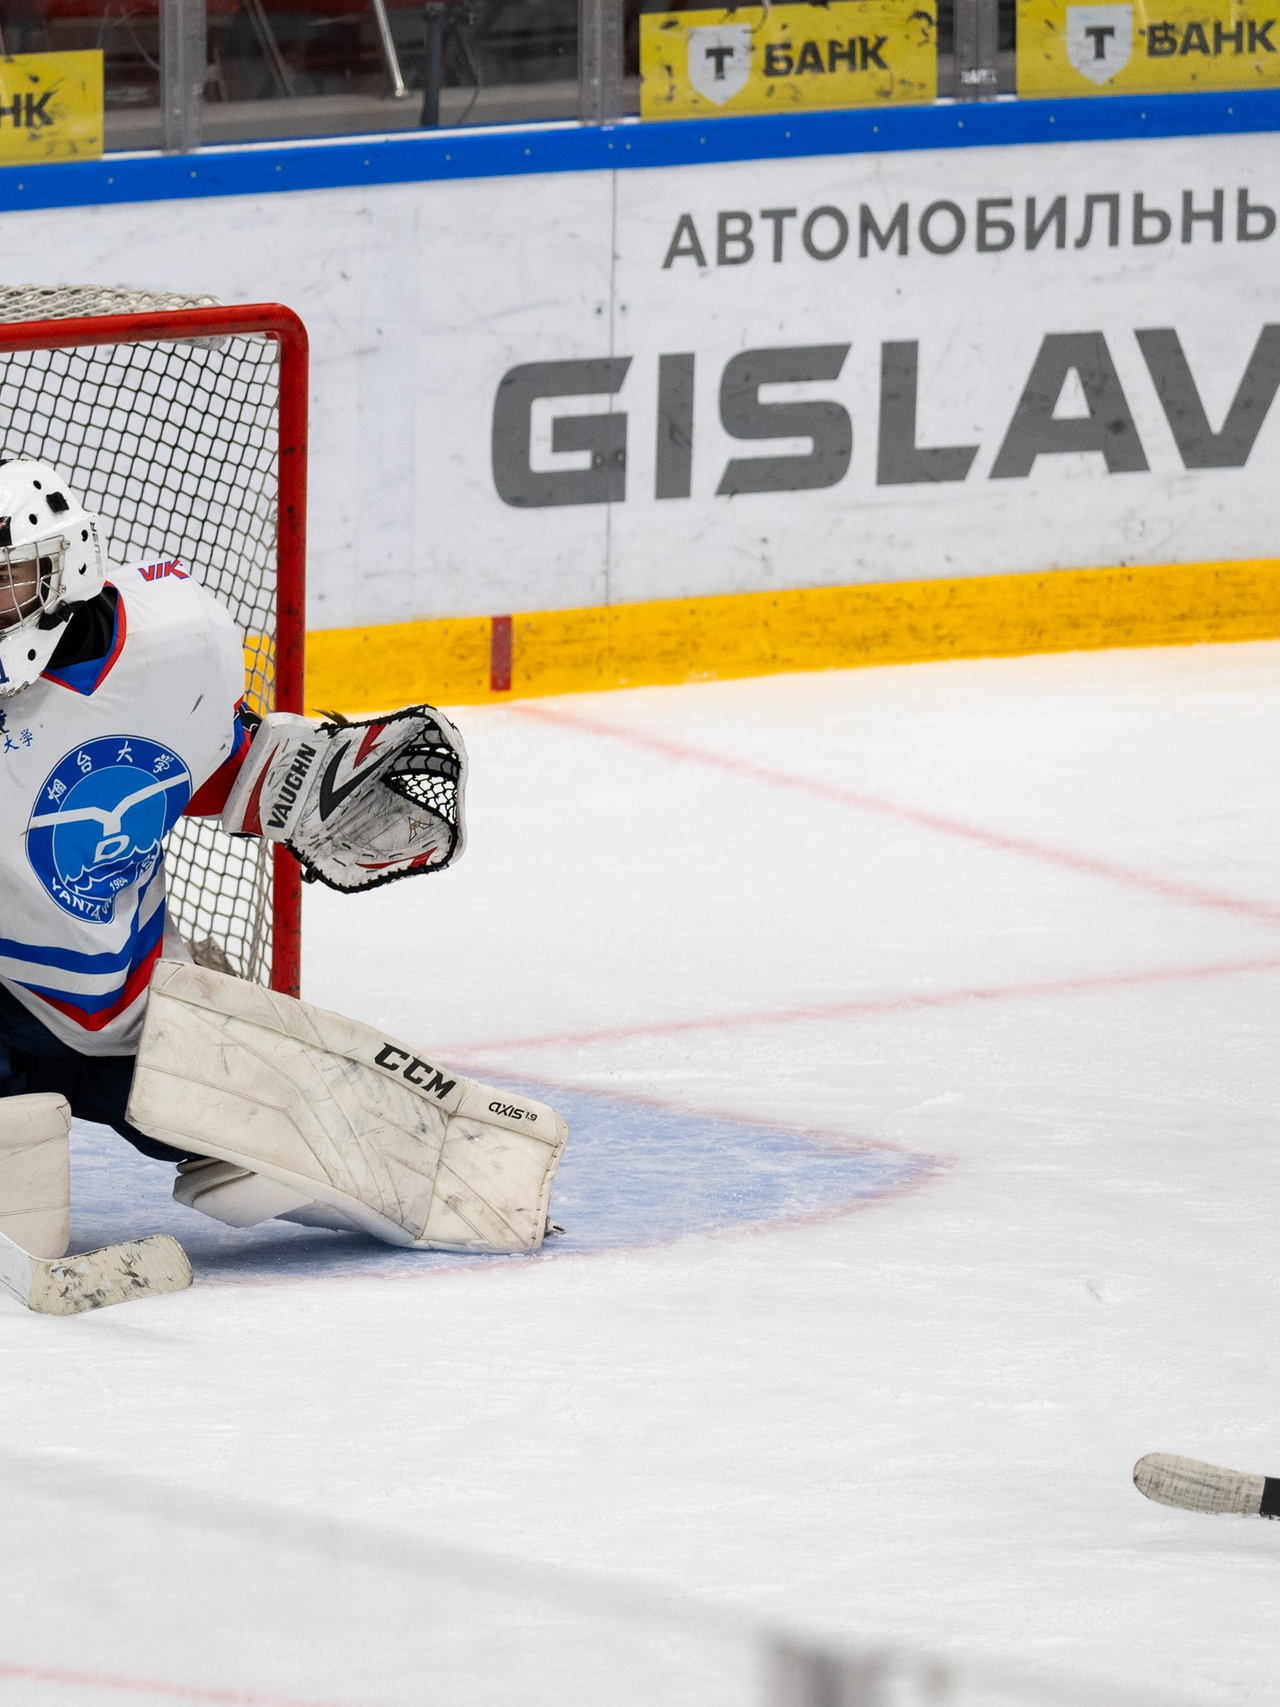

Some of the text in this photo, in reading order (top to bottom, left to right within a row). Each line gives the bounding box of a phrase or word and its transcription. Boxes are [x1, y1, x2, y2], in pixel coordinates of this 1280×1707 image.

[763, 35, 889, 77] БАНК
[1146, 18, 1278, 58] БАНК
[490, 323, 1280, 508] GISLAV
[266, 742, 317, 829] VAUGHN
[374, 1041, 457, 1100] CCM
[525, 1110, 538, 1123] 1.9
